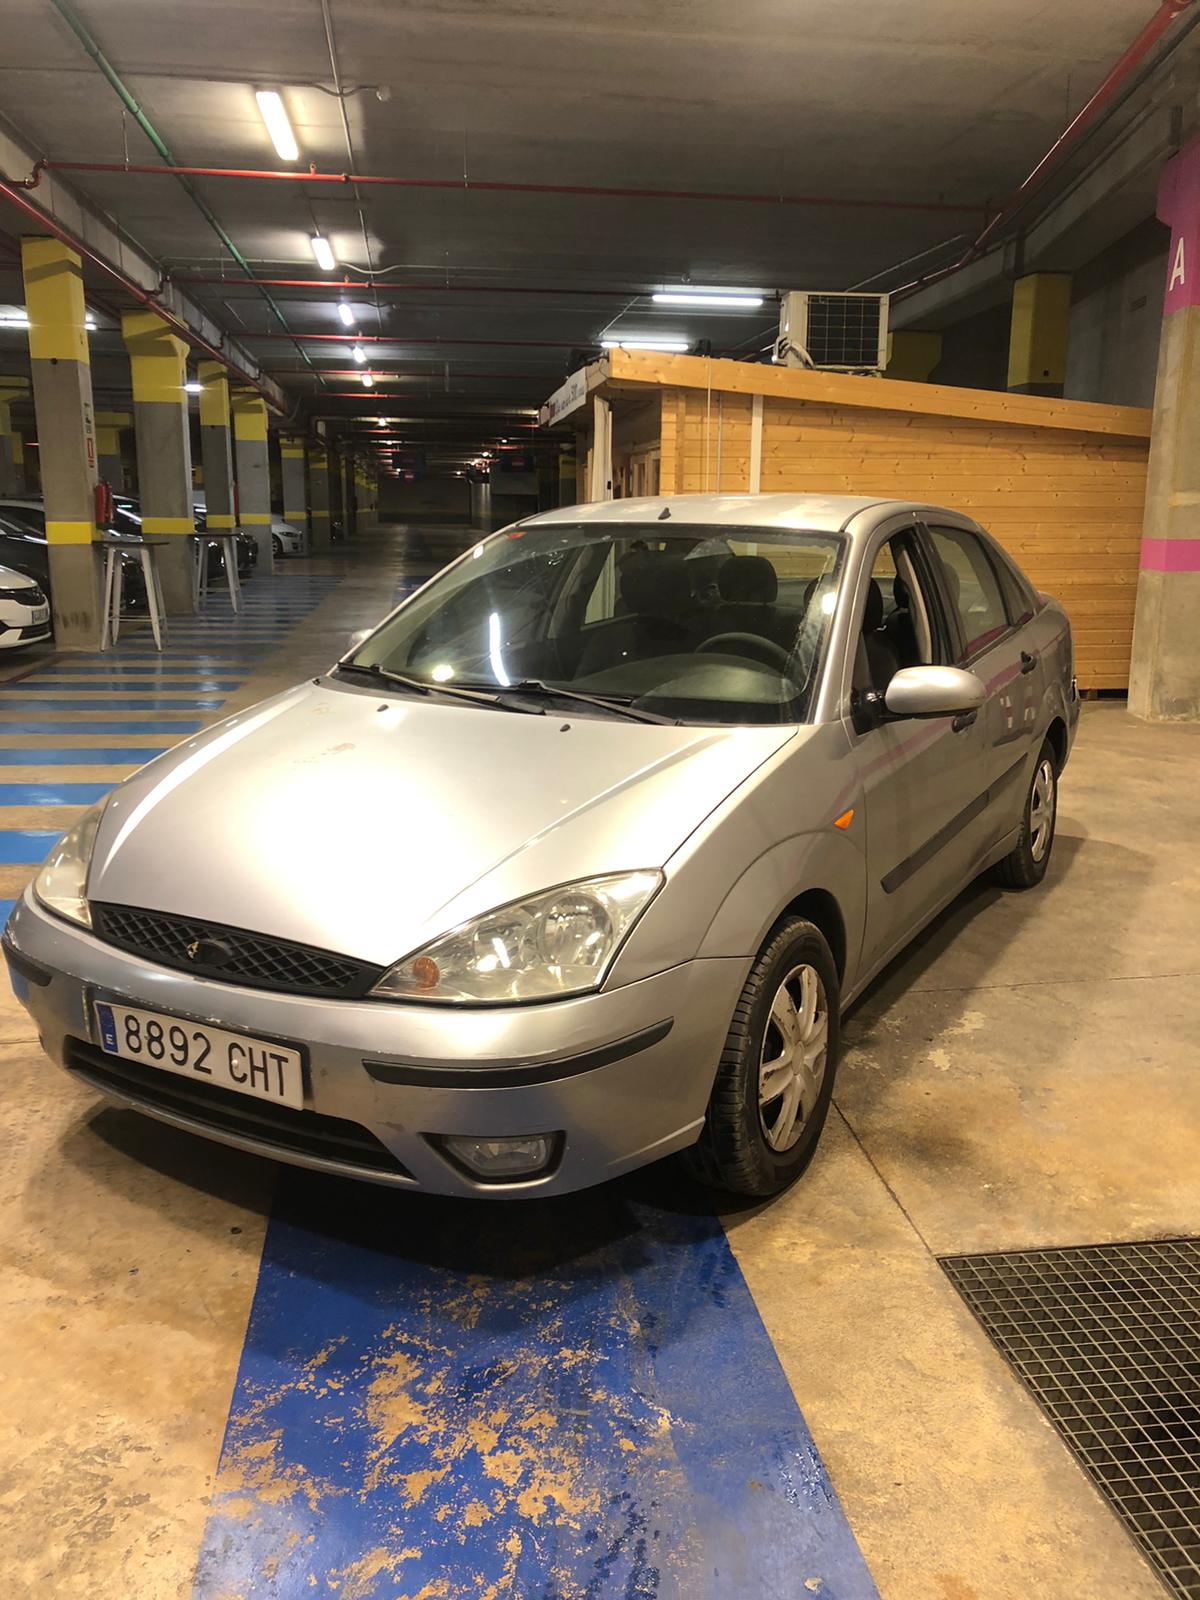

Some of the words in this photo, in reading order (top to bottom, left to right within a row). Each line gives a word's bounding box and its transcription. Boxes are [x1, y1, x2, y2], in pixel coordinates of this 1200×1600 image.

[1169, 237, 1185, 291] A
[105, 1033, 114, 1045] E
[124, 1014, 212, 1075] 8892
[228, 1042, 289, 1096] CHT
